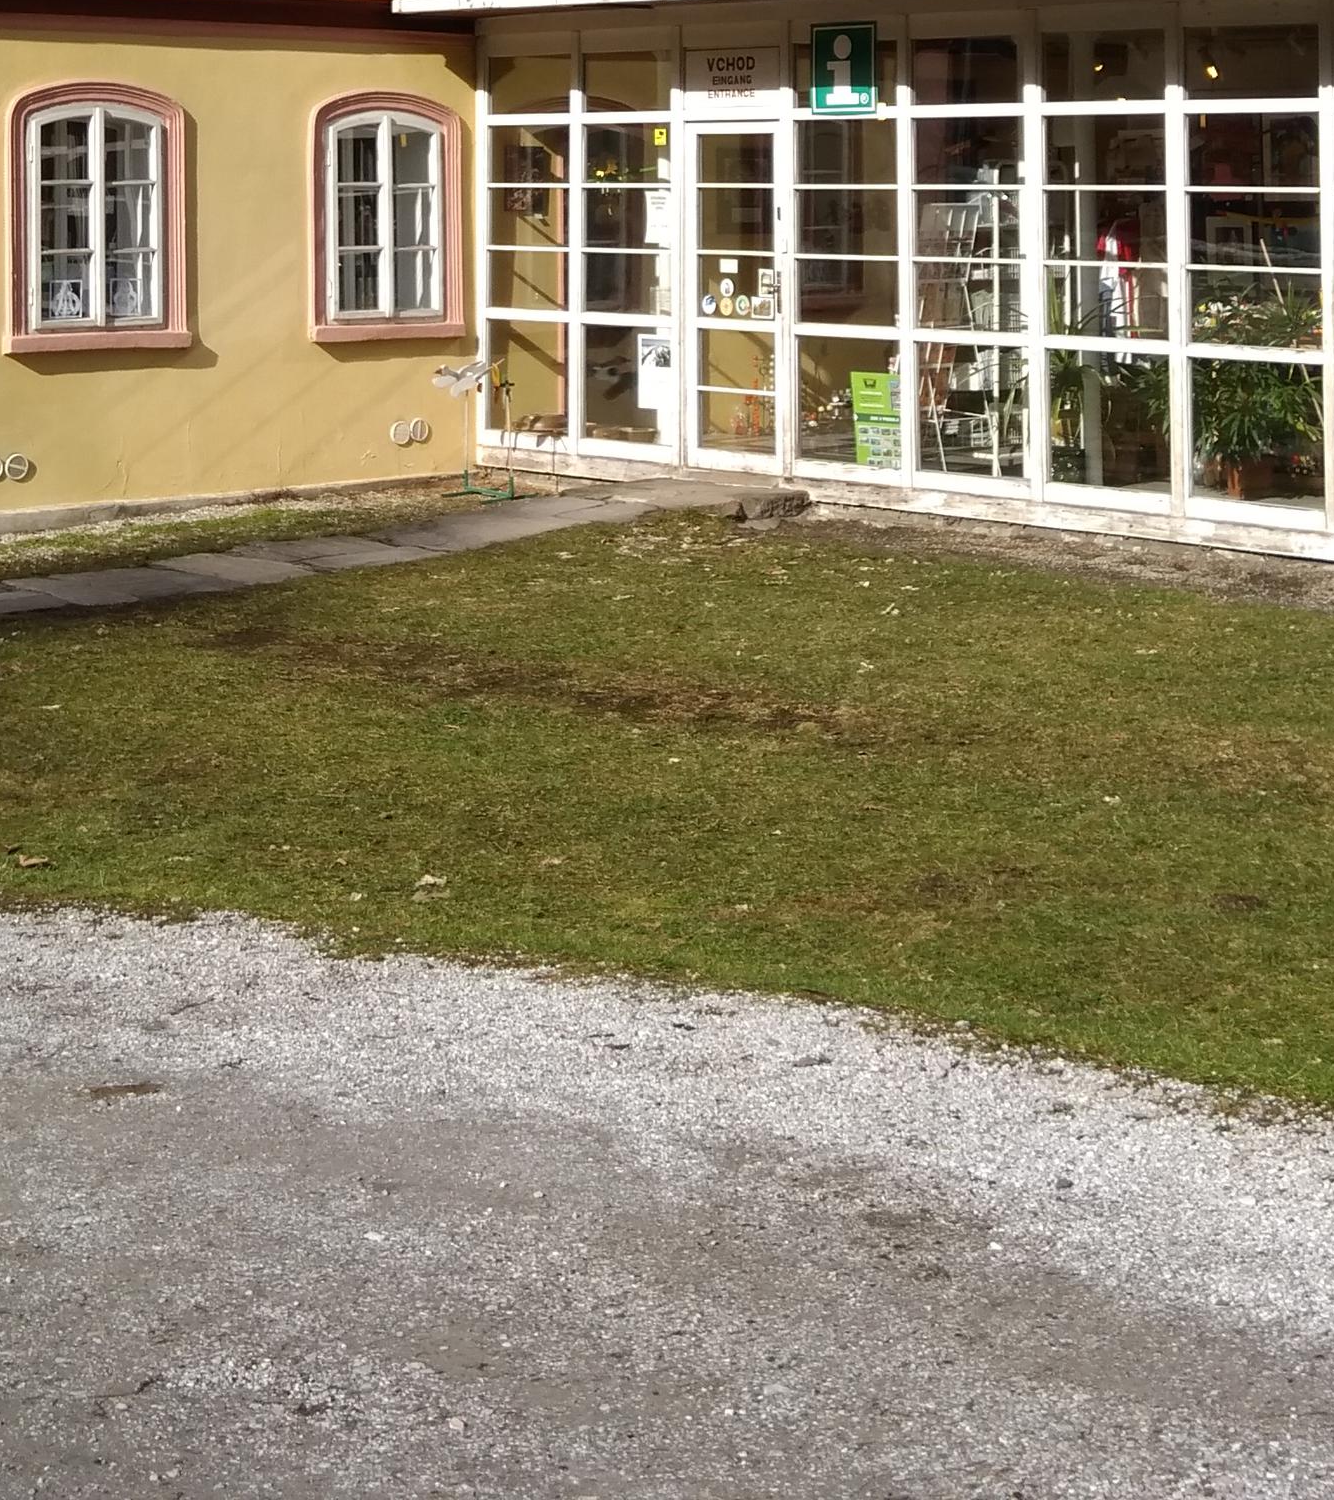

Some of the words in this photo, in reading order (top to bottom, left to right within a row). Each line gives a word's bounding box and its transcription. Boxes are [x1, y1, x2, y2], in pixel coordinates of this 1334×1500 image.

[707, 56, 756, 72] VCHOD
[712, 75, 752, 85] EINGANG
[708, 88, 756, 99] ENTRANCE
